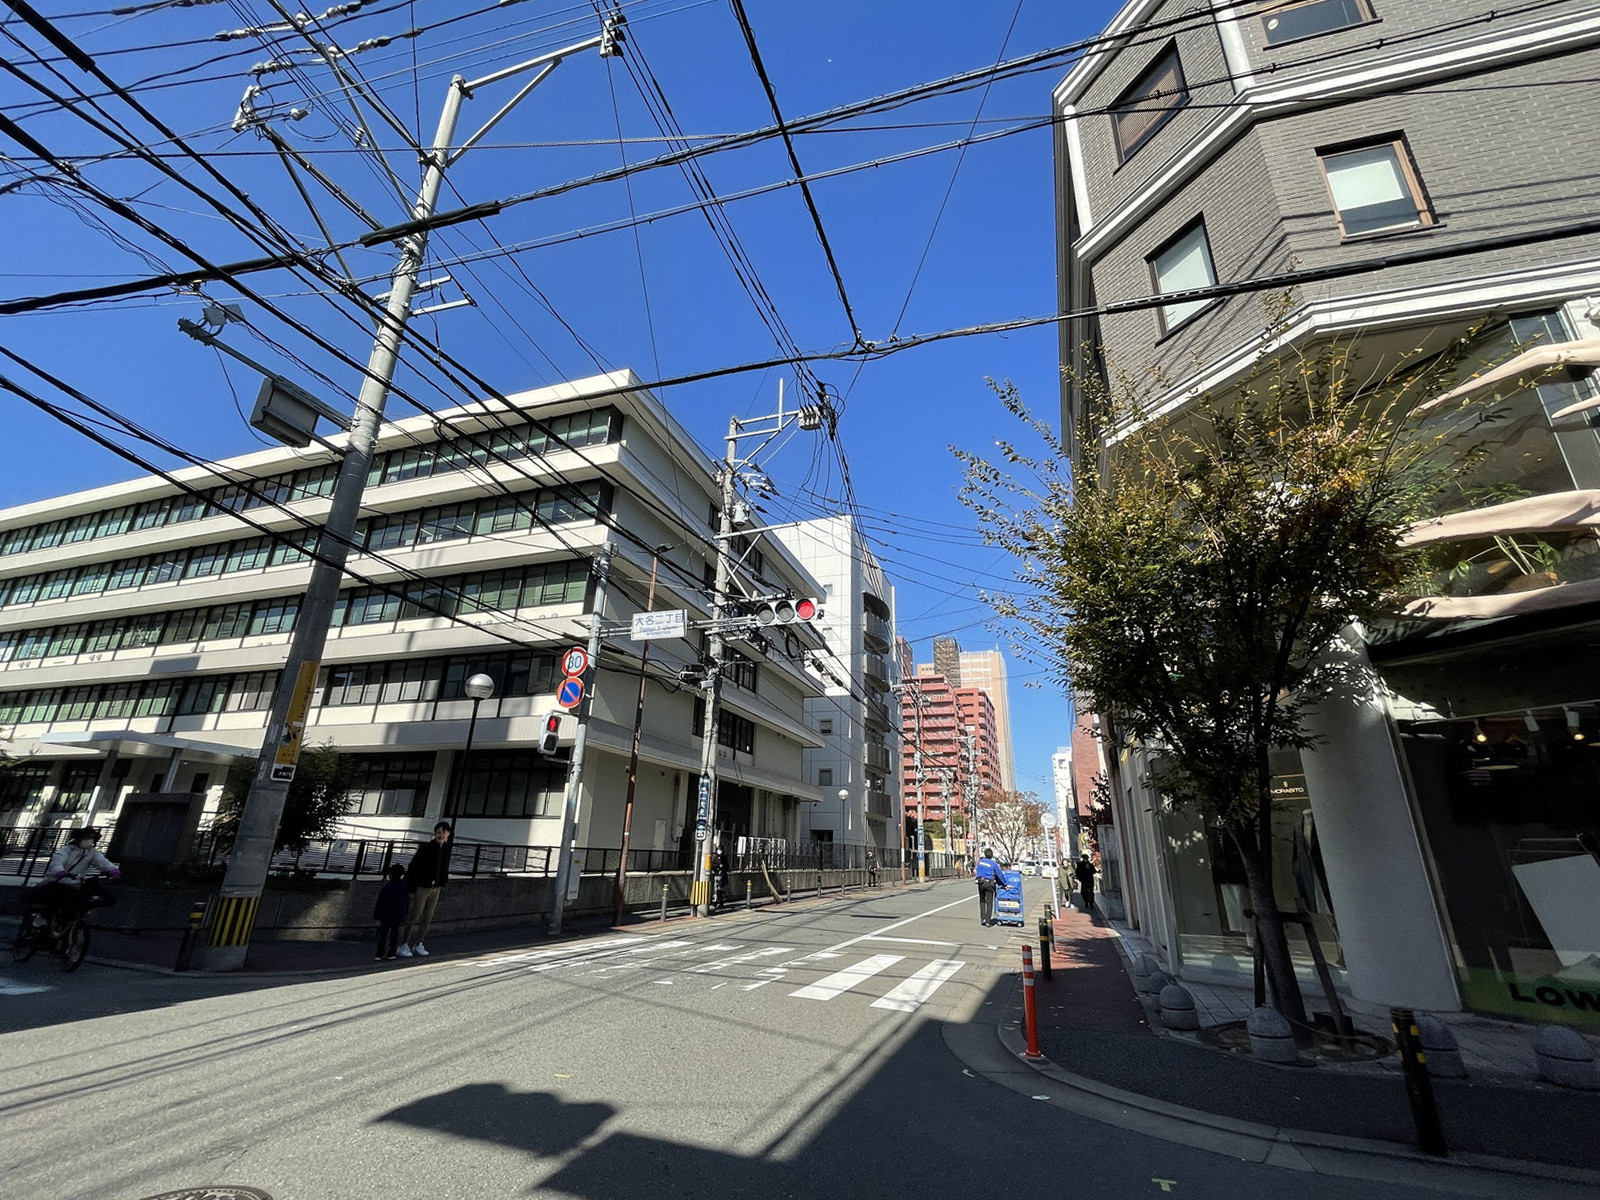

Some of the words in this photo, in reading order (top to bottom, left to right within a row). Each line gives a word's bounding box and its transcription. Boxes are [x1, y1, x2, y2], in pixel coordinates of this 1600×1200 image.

[635, 613, 685, 626] 大名二丁目
